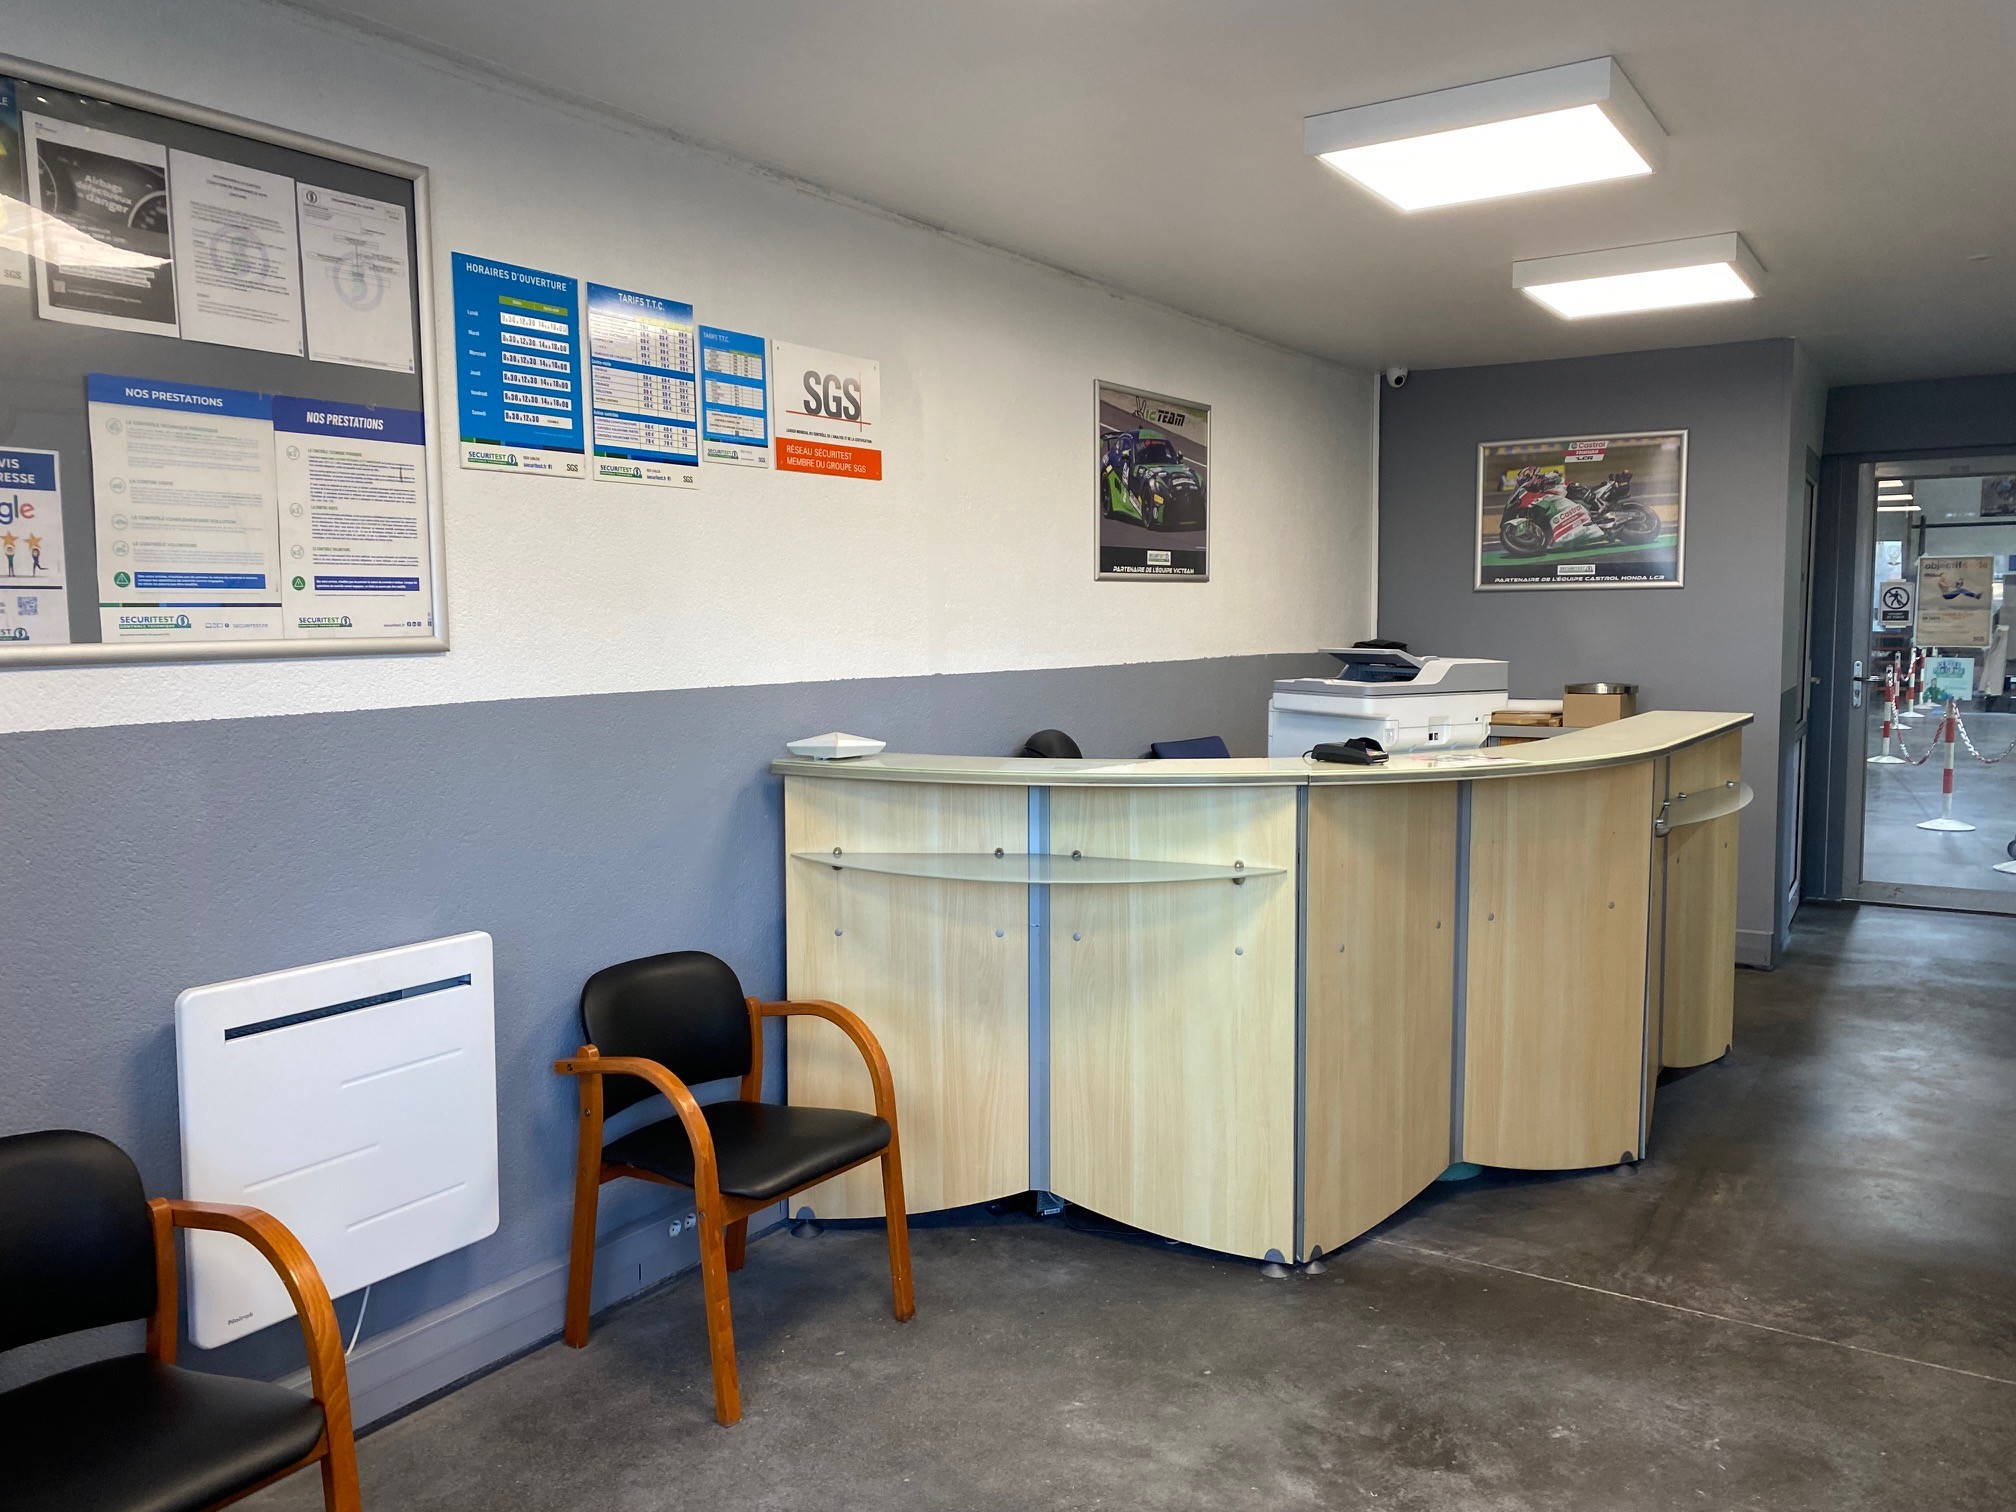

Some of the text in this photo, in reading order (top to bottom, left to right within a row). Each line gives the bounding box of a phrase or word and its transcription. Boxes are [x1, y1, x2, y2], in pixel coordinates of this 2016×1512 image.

[86, 193, 129, 214] danger
[4, 269, 22, 280] SGS
[466, 262, 567, 292] HORAIRES D'OUVERTURE
[618, 293, 665, 311] TARIFS T.T.C.
[703, 332, 718, 340] TARIFS
[126, 388, 223, 407] NOS PRESTATIONS
[803, 370, 860, 420] SGS
[306, 412, 384, 430] NOS PRESTATIONS
[468, 452, 506, 460] SECURITEST
[786, 444, 812, 456] RÉSEAU
[787, 457, 866, 473] MEMBRE DU GROUPE SGS
[1560, 505, 1583, 520] Castrol
